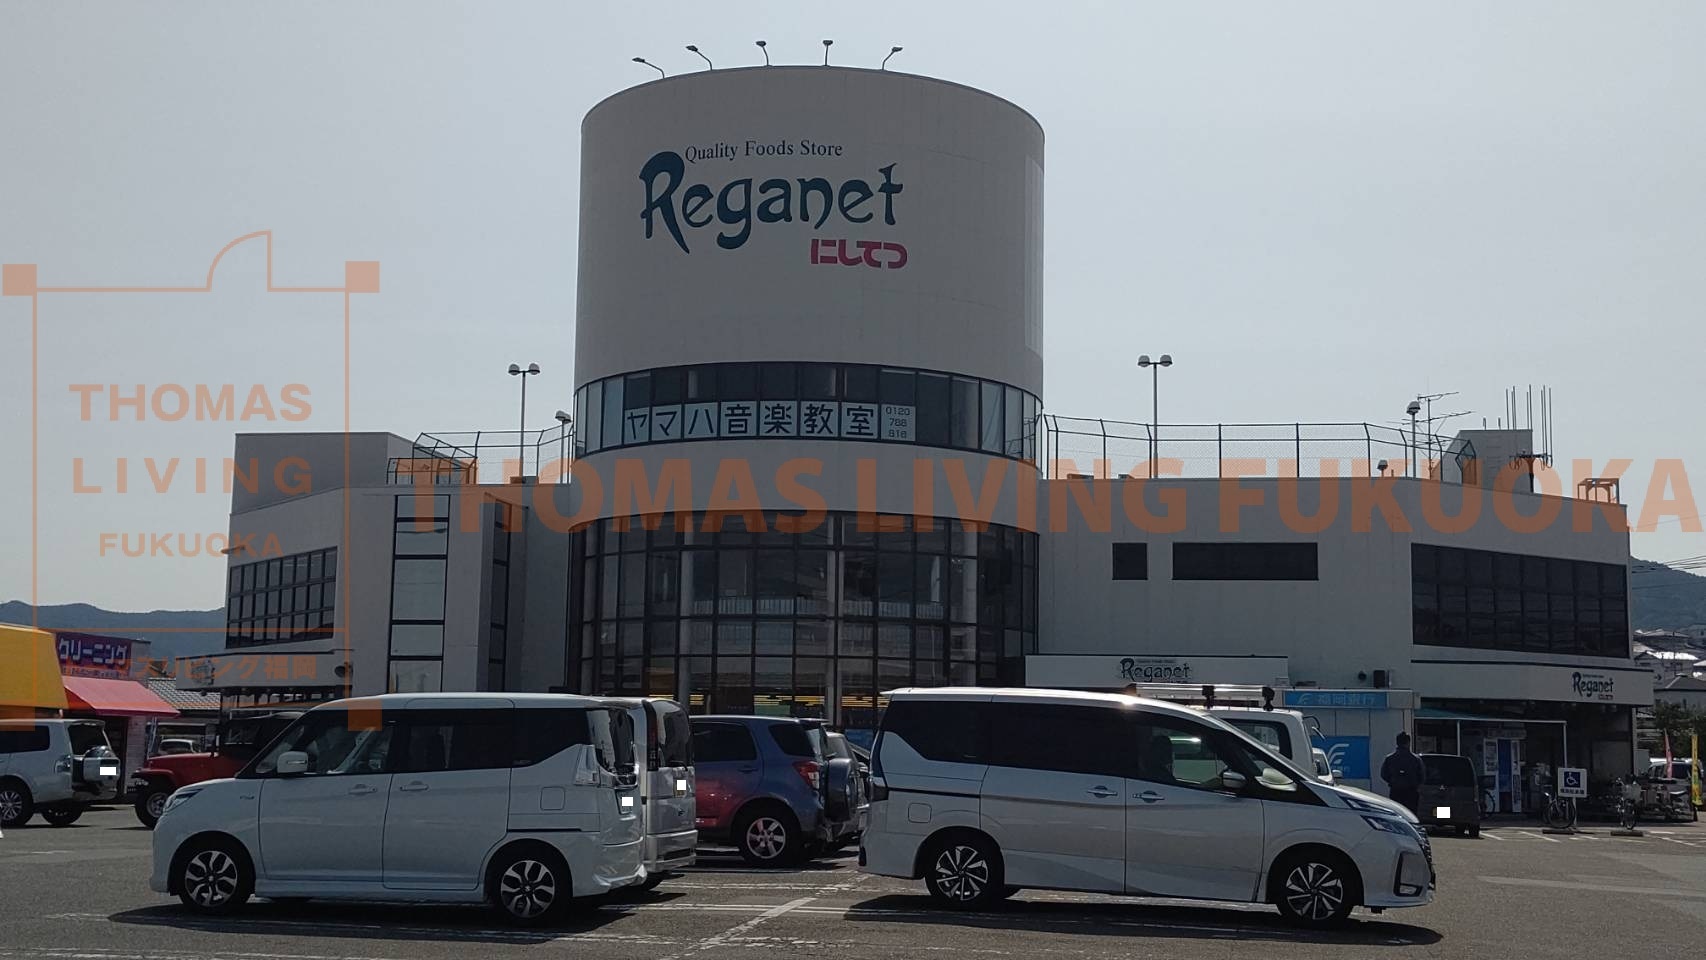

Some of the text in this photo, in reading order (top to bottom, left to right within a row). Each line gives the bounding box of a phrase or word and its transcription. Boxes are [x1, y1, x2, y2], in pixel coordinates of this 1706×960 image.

[685, 139, 843, 162] Quality Foods Store
[639, 151, 903, 254] Reganet
[810, 238, 908, 269] にしてつ
[626, 402, 875, 440] ヤマハ音楽教室
[886, 406, 910, 416] 0120
[59, 638, 127, 666] クリーニング
[1120, 657, 1190, 682] Reganet
[1572, 671, 1614, 698] Reganet
